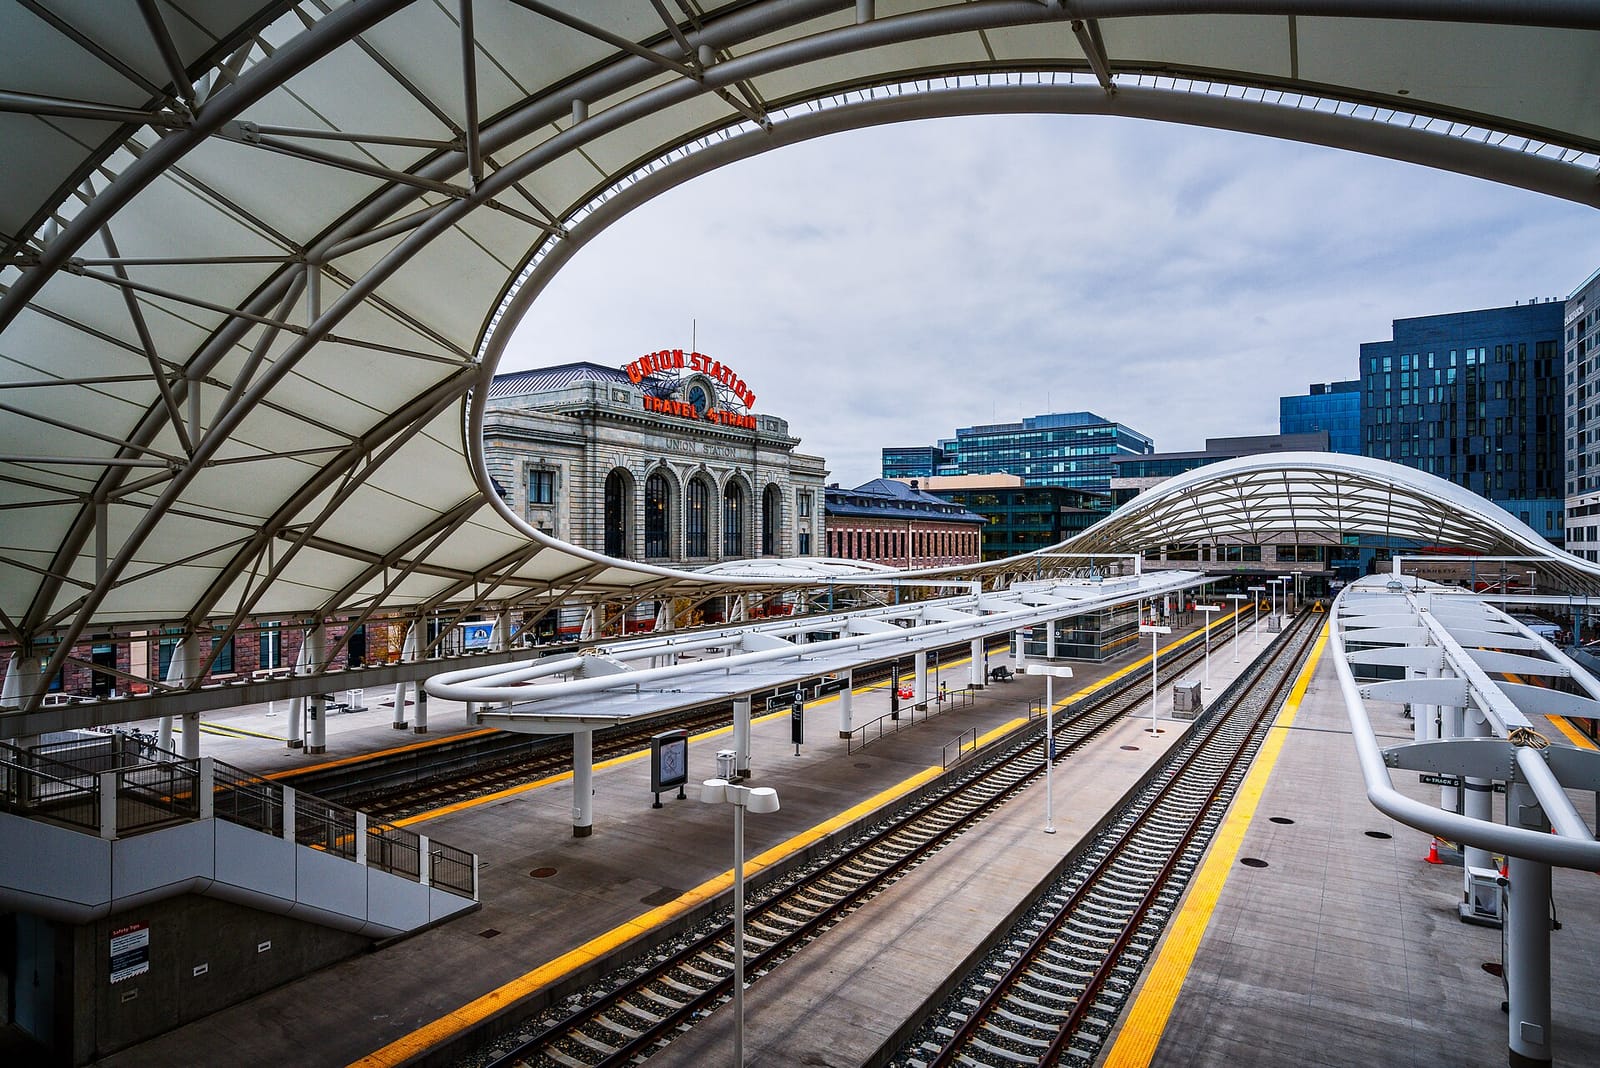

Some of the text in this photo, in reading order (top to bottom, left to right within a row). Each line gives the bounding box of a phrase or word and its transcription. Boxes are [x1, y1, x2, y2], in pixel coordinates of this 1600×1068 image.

[626, 349, 757, 410] UNION STATION
[643, 395, 698, 418] TRAVEL
[719, 409, 757, 430] TRAIN
[665, 438, 737, 458] UNION STATION
